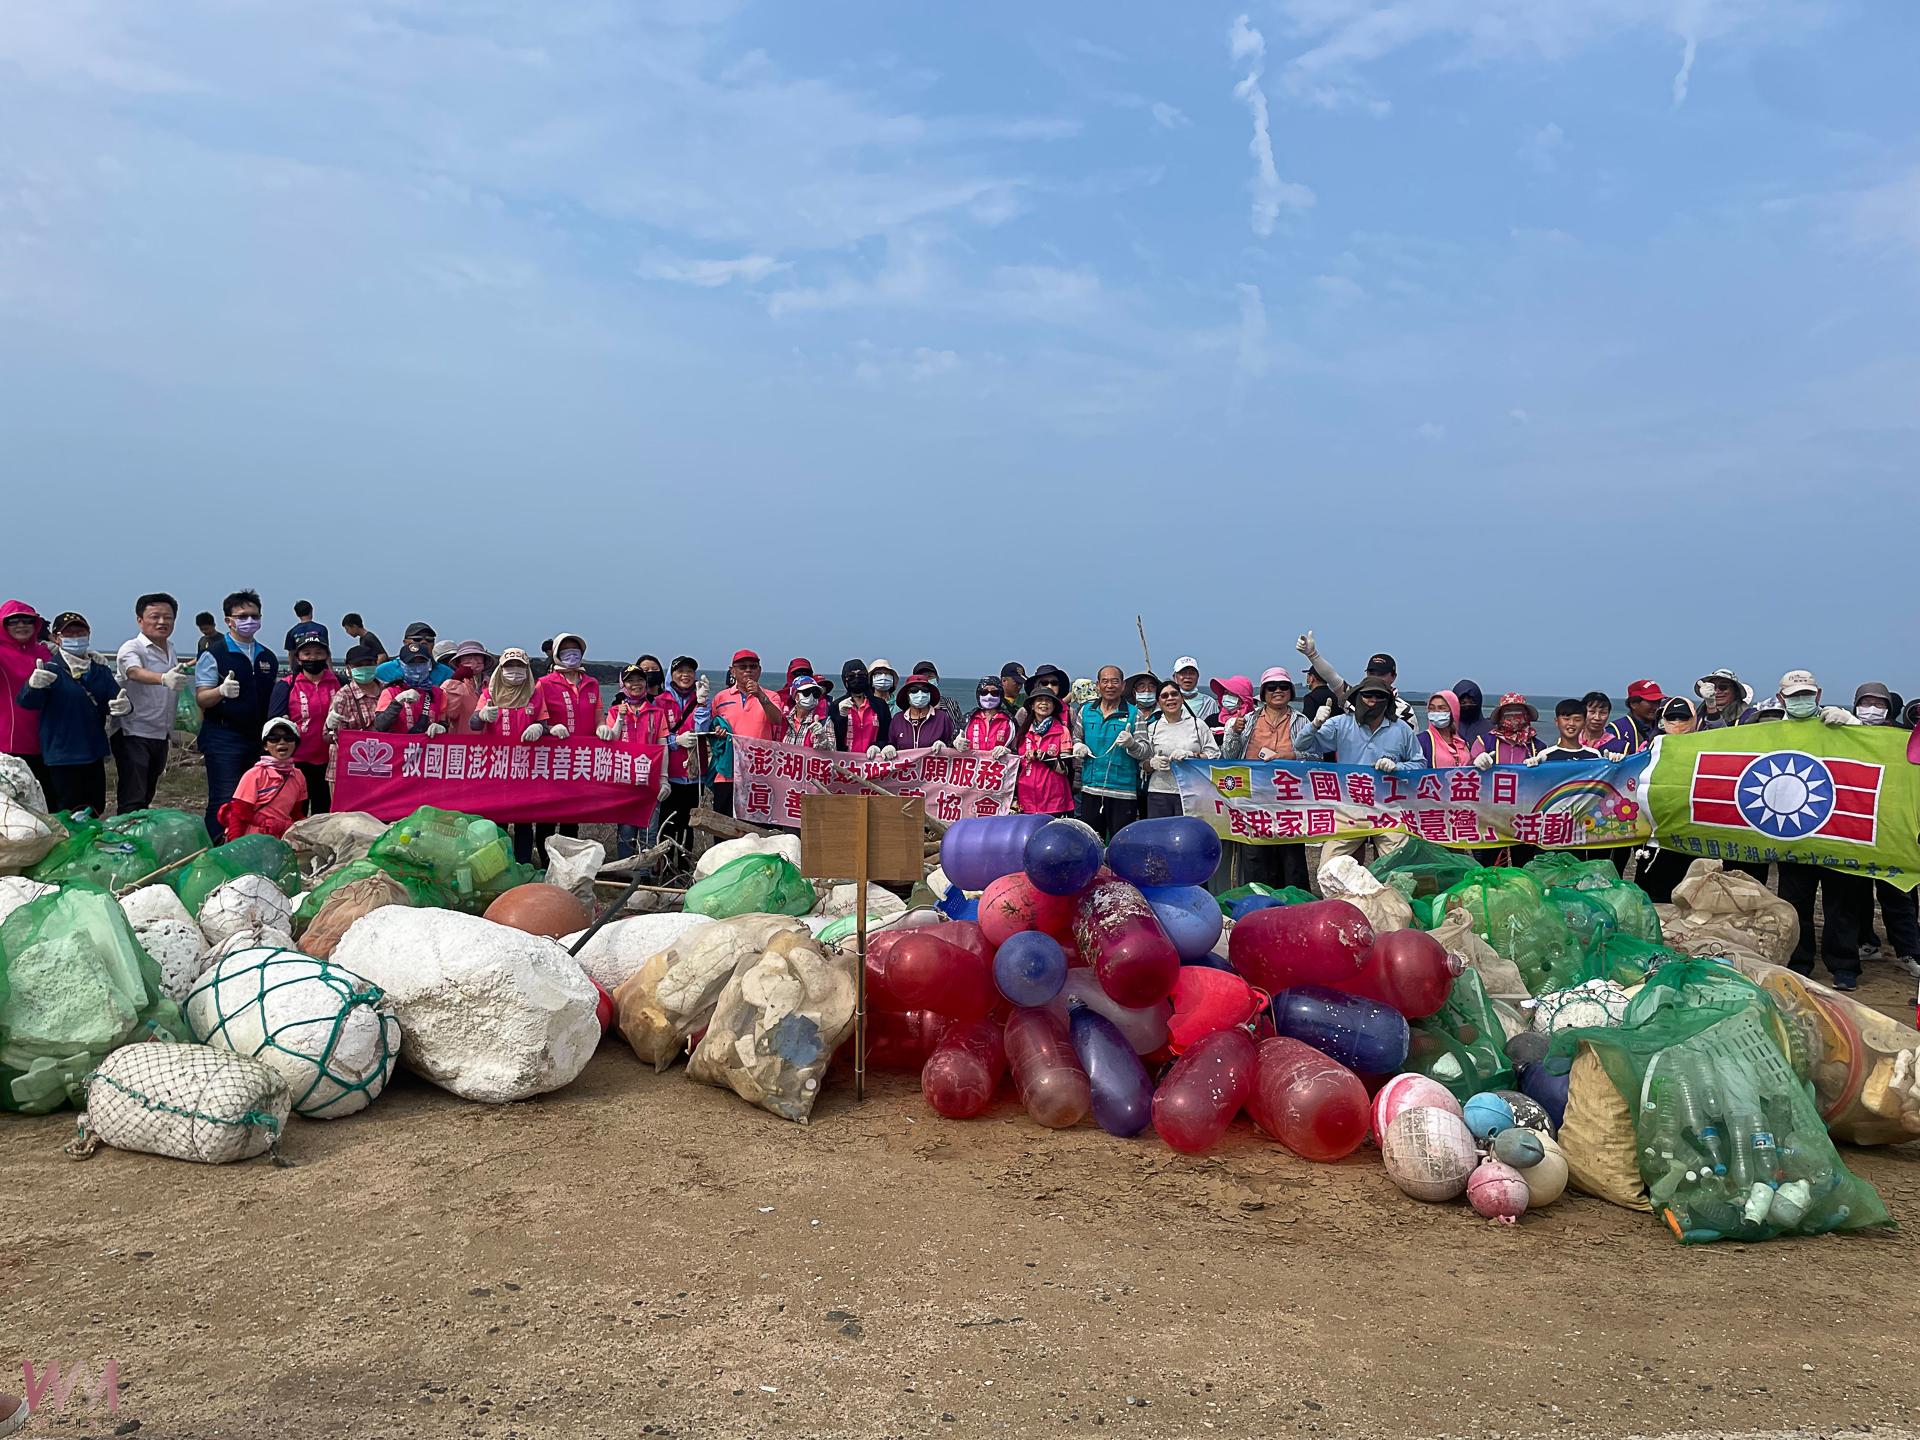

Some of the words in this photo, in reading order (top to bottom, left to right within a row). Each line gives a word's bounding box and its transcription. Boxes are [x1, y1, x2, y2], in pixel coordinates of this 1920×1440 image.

[402, 741, 653, 786] 救國團澎湖縣真善美聯誼會
[1272, 770, 1519, 806] 全國義工公益日
